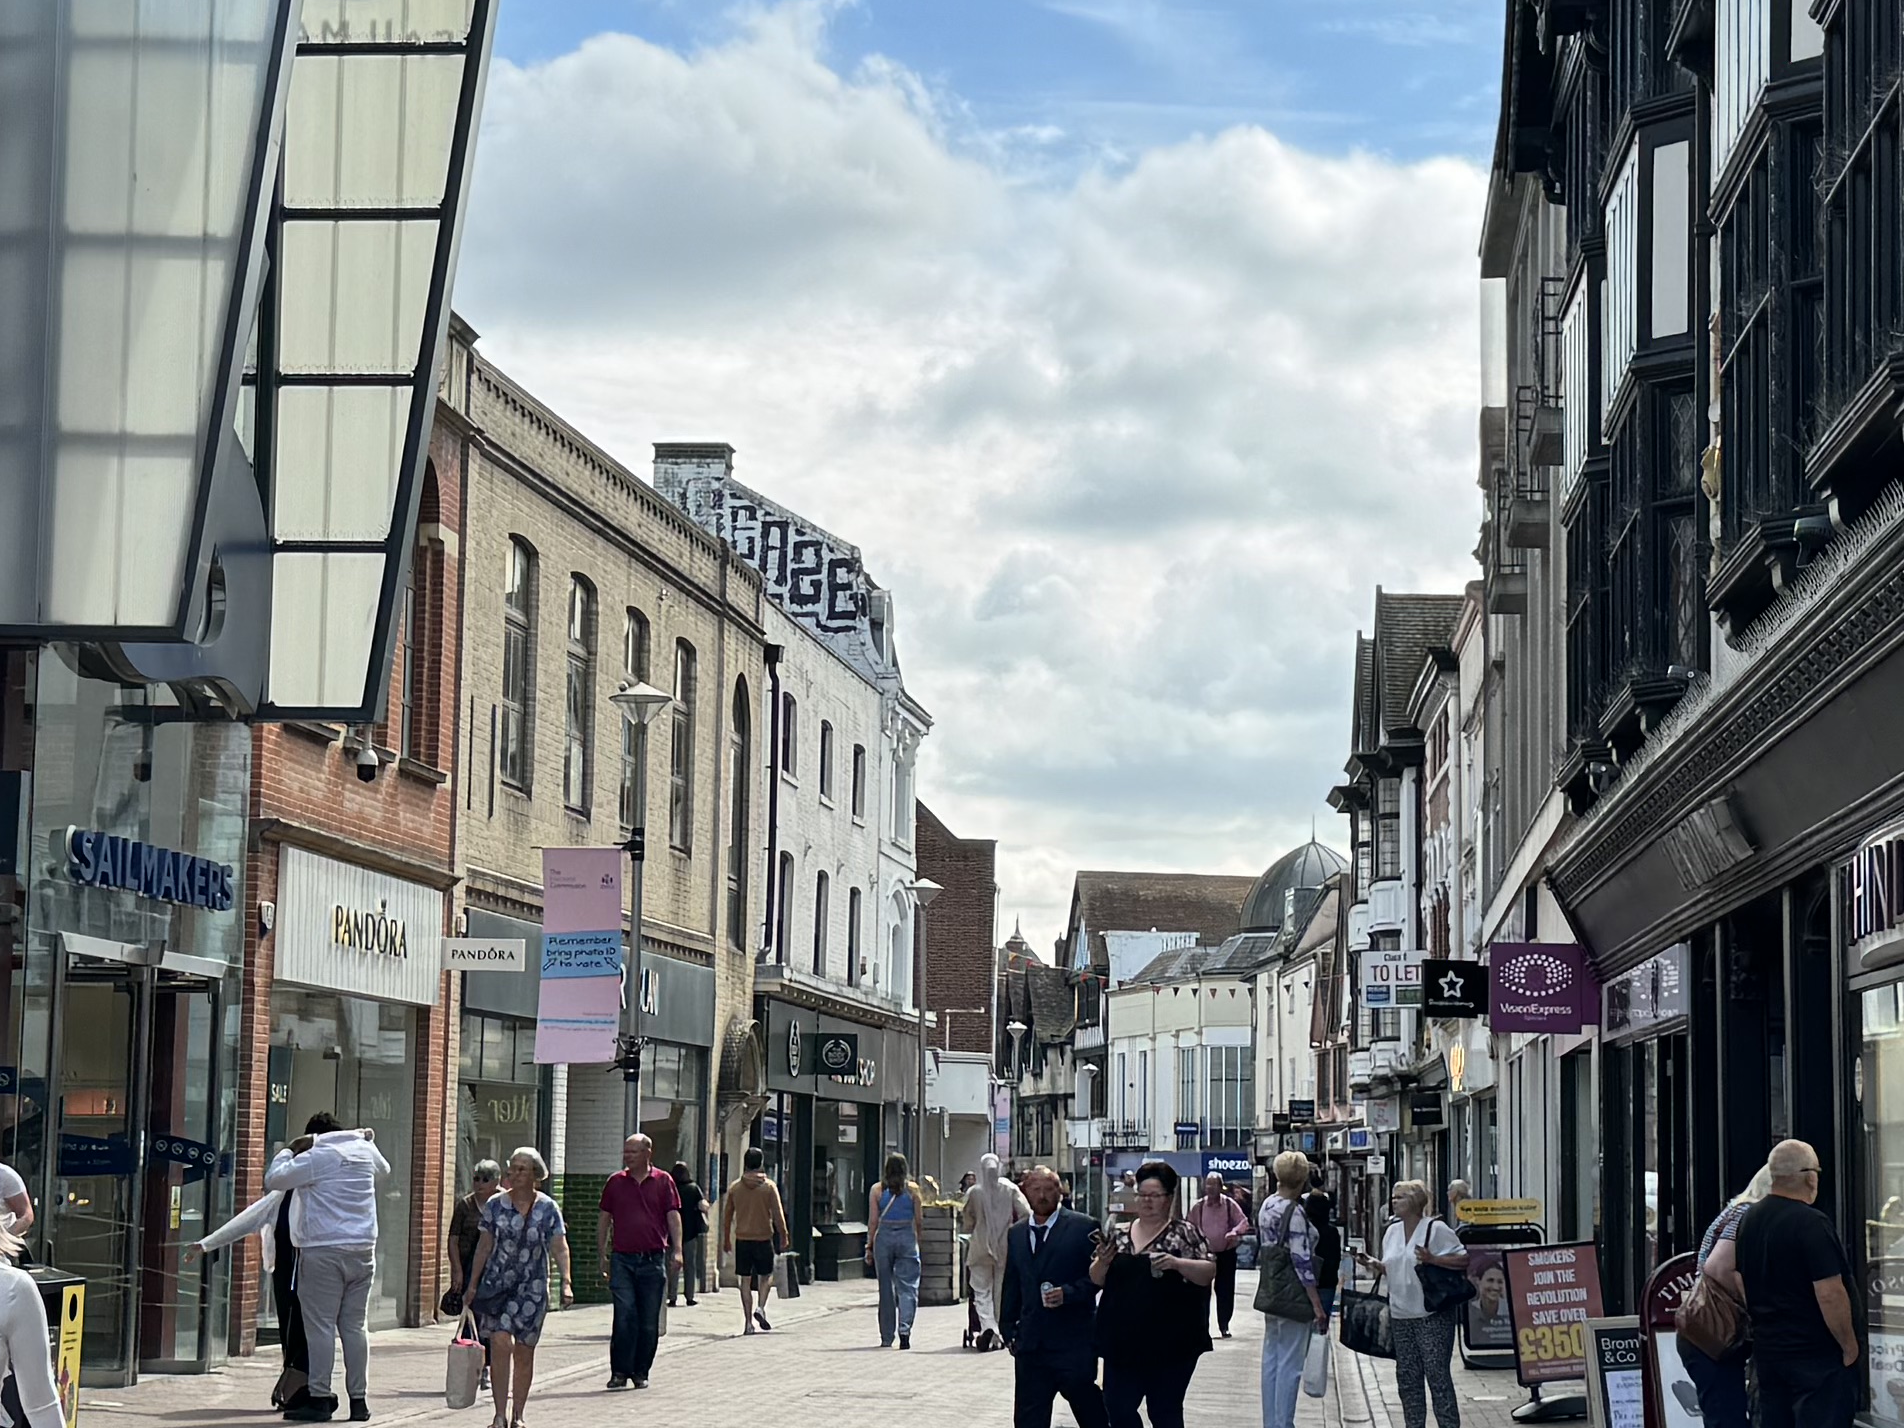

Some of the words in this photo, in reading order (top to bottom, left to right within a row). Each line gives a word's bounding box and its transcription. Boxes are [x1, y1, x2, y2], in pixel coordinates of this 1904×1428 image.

[76, 829, 234, 911] SAILMAKERS
[334, 902, 408, 959] PANDORA
[548, 937, 613, 946] Remember
[451, 948, 515, 961] PANDORA
[546, 947, 573, 959] bring
[574, 948, 604, 959] photo
[605, 947, 616, 956] ID
[560, 960, 572, 968] to
[575, 960, 603, 968] vote
[1370, 965, 1390, 982] TO
[1395, 965, 1422, 982] LET
[1528, 1249, 1576, 1266] SMOKERS
[1533, 1271, 1555, 1285] JOIN
[1555, 1269, 1576, 1284] THE
[1526, 1288, 1587, 1306] REVOLUTION
[1532, 1309, 1559, 1325] SAVE
[1560, 1308, 1587, 1323] OVER
[1519, 1322, 1586, 1363] £350
[1605, 1352, 1615, 1363] &
[1616, 1351, 1637, 1363] Co
